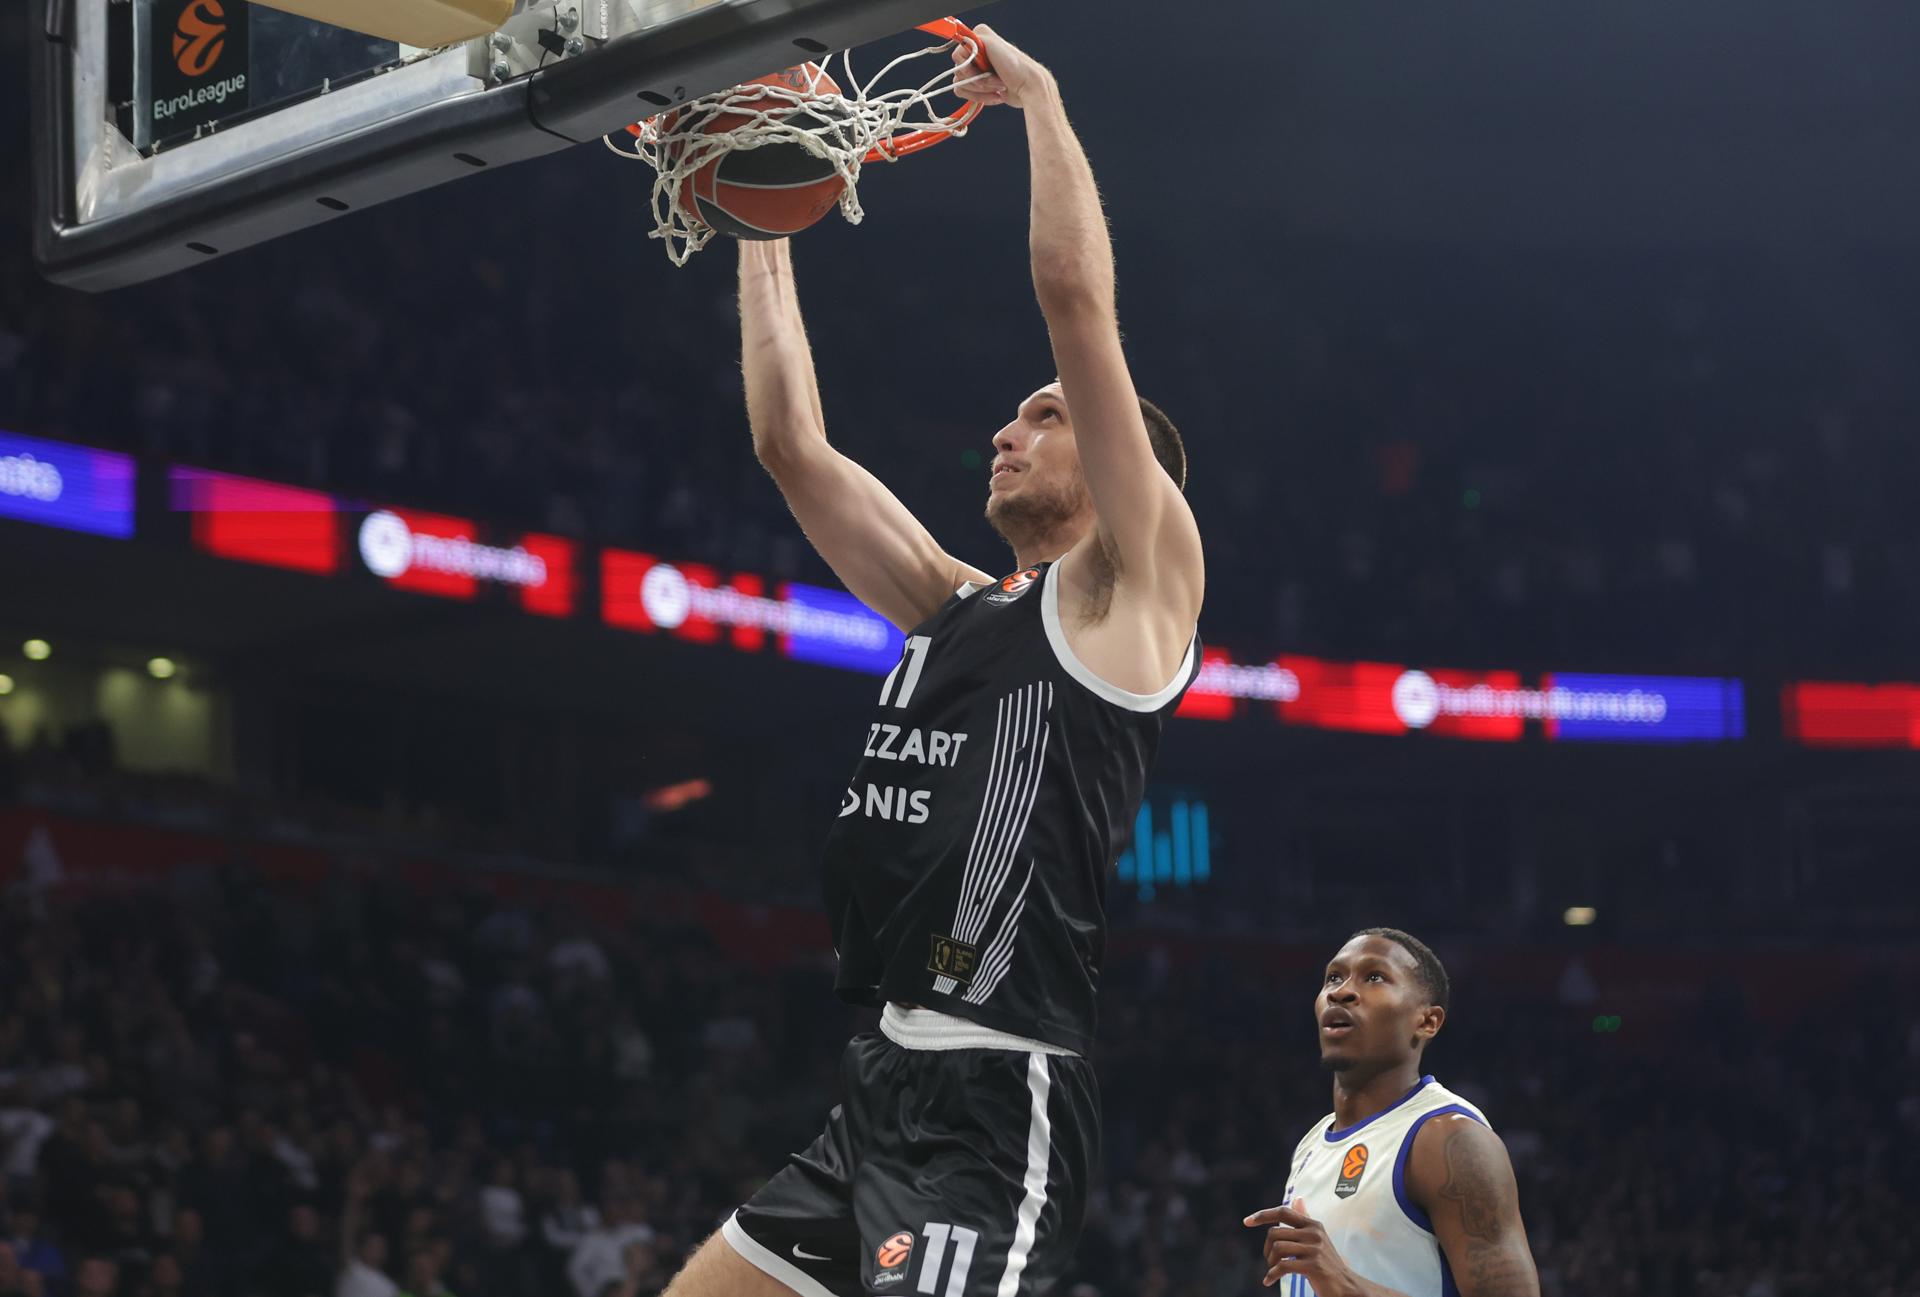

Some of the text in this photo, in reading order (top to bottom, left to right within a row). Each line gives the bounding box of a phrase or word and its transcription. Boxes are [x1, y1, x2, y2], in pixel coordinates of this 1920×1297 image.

[153, 73, 246, 120] EuroLeague
[864, 723, 969, 768] ZZART
[917, 1221, 979, 1297] 11
